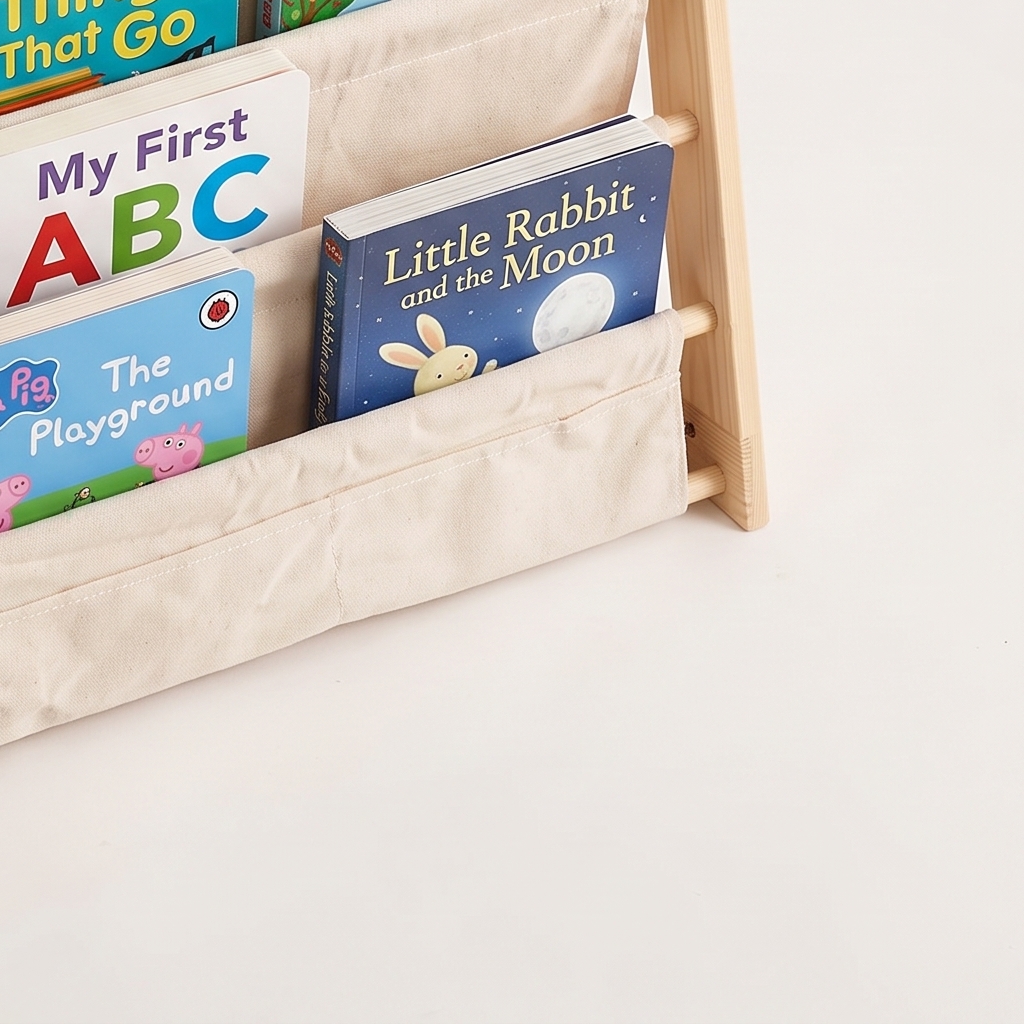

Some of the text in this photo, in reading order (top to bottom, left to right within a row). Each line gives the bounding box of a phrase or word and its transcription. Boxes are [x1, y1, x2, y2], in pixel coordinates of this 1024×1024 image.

[112, 9, 196, 59] Go
[38, 108, 249, 201] My First
[6, 153, 271, 308] ABC
[383, 223, 491, 286] Little
[504, 180, 636, 249] Rabbit
[400, 231, 616, 311] and the Moon
[11, 366, 55, 406] Pig
[30, 357, 235, 457] Playground
[100, 354, 172, 393] The
